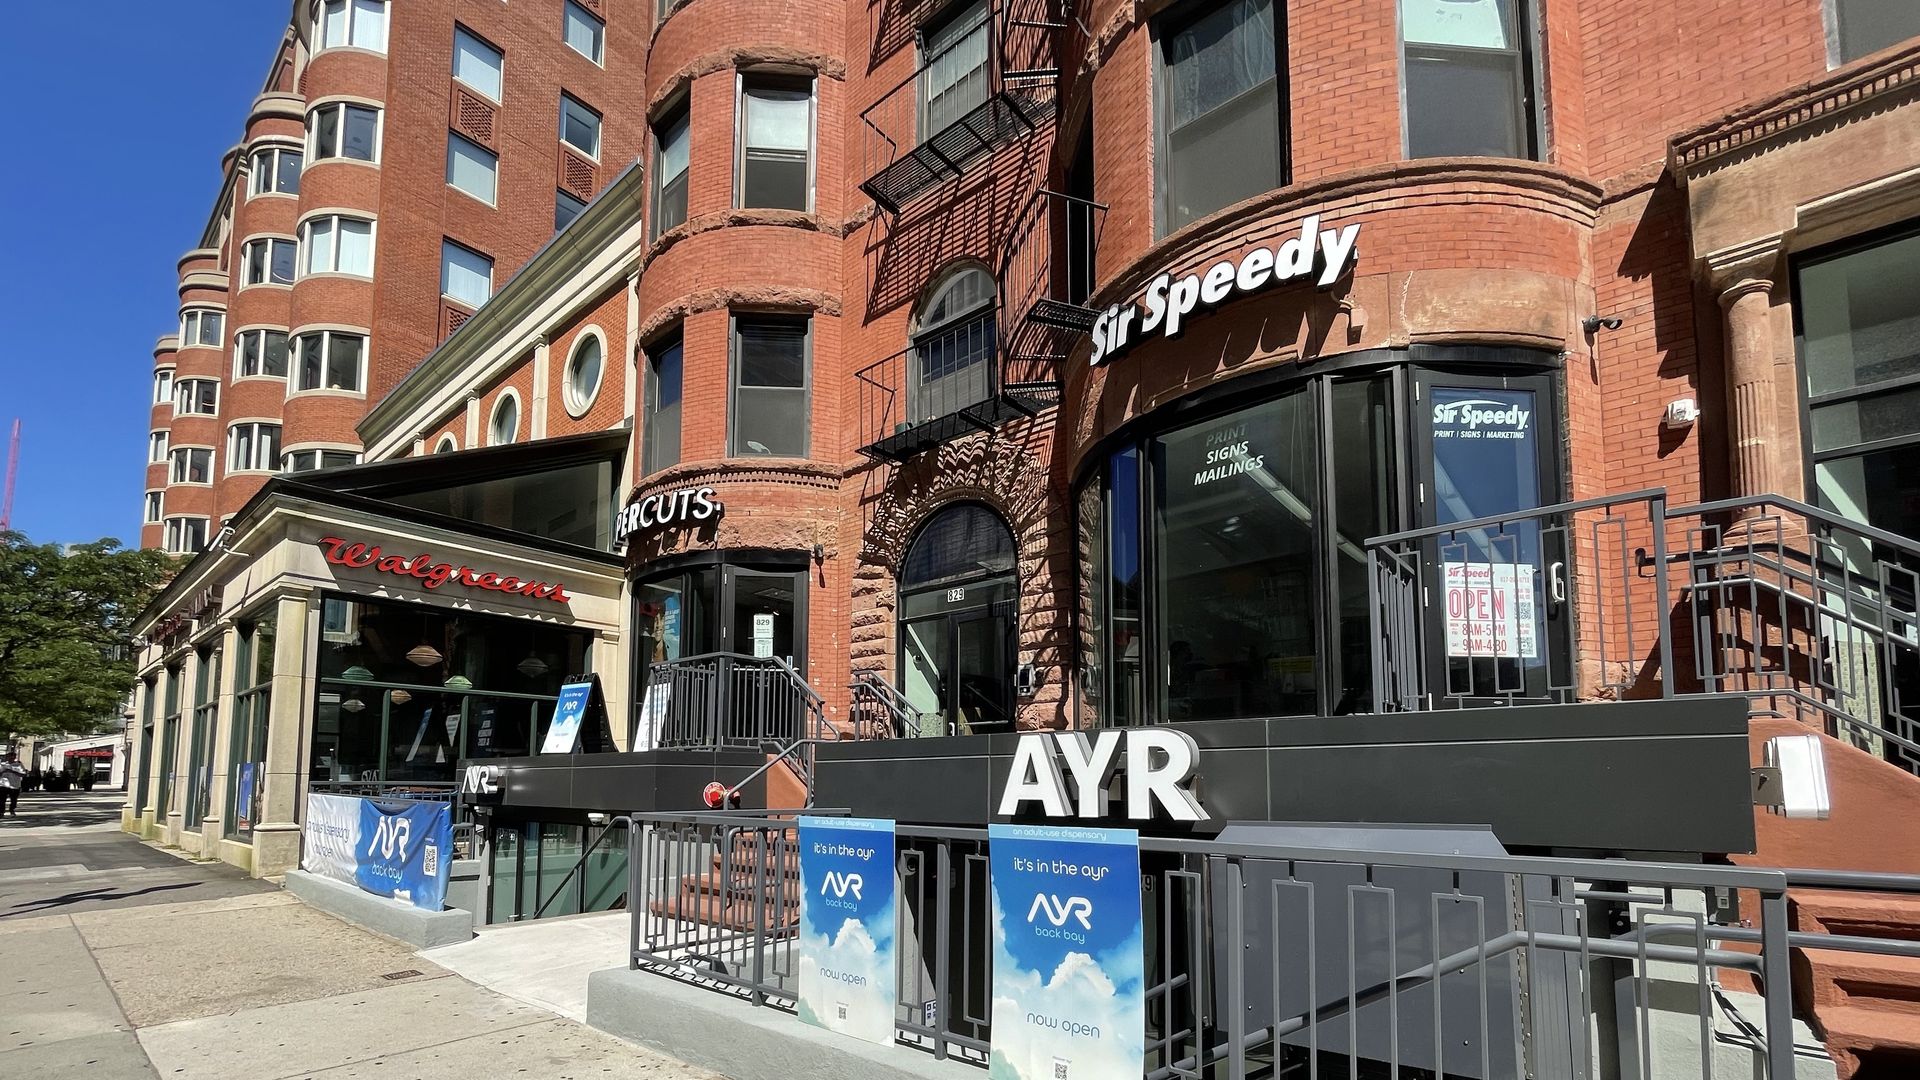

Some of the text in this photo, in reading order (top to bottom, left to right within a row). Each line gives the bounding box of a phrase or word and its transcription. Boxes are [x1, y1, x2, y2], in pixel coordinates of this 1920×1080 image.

[1090, 214, 1361, 366] Sir Speedy
[1433, 403, 1458, 424] Sir
[1206, 423, 1249, 447] PRINT
[1433, 430, 1525, 439] PRINT SIGNS MARKETING
[1206, 440, 1249, 465] SIGNS
[1193, 454, 1265, 486] MAILINGS
[318, 536, 572, 603] Walgreens
[1448, 567, 1460, 577] Sir
[948, 588, 964, 601] 829
[1448, 588, 1505, 620] OPEN
[562, 700, 578, 711] AYR
[462, 765, 498, 795] AYR
[998, 728, 1212, 821] AYR
[368, 816, 412, 863] AYR
[1012, 827, 1107, 841] an adult-use dispensary
[813, 841, 875, 860] it's in the ayr
[371, 860, 403, 884] back bay
[1013, 857, 1109, 881] it's in the ayr
[821, 870, 863, 900] AYR
[826, 897, 858, 913] back bay
[1027, 893, 1093, 931] AYR
[1035, 925, 1085, 945] back bay
[820, 967, 867, 987] now open
[1026, 1012, 1100, 1039] now open
